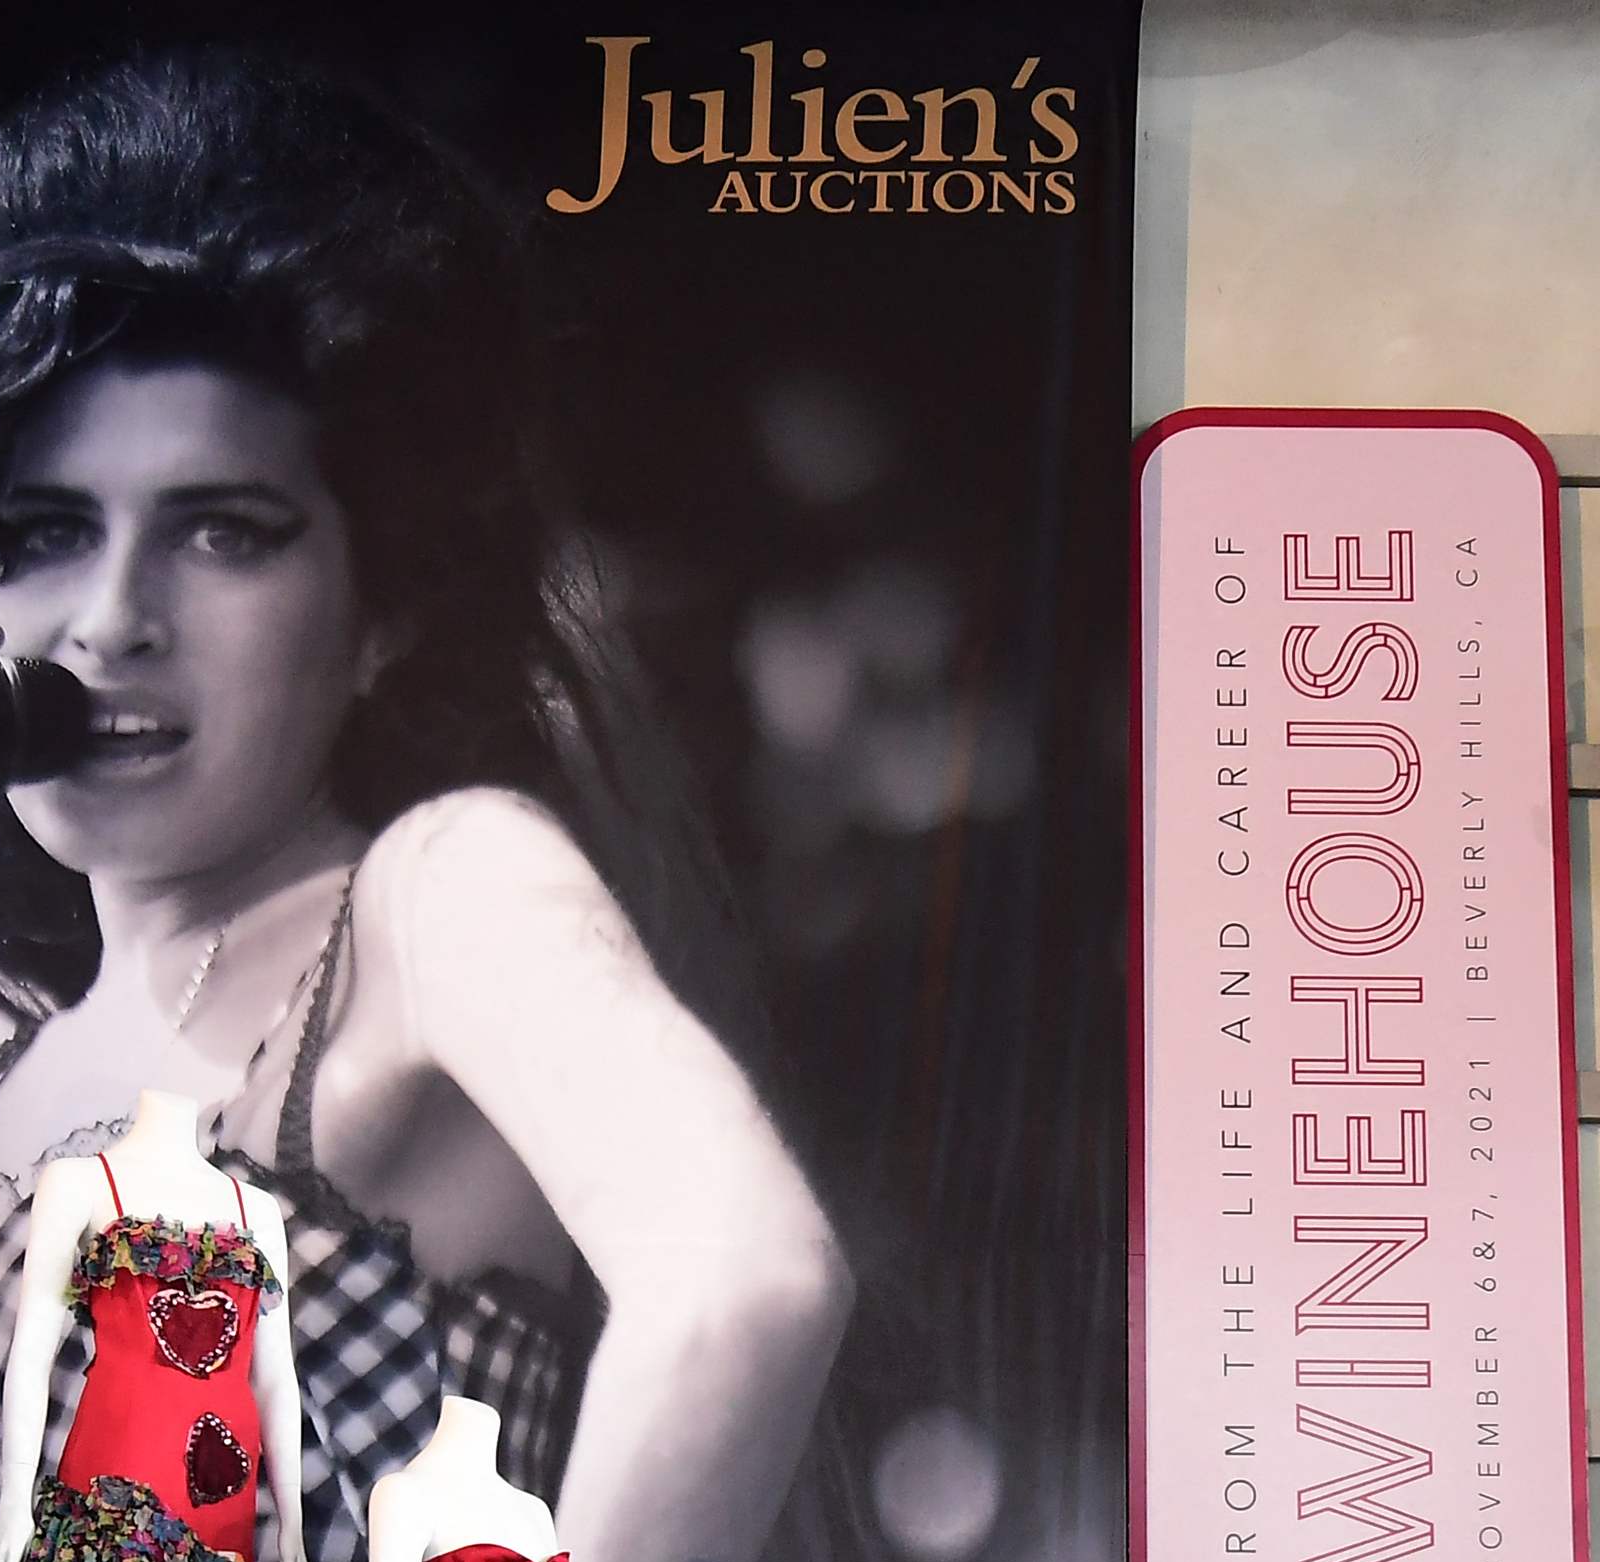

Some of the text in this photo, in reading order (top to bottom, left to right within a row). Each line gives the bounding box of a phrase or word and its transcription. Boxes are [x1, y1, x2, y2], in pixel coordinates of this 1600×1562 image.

[546, 36, 1079, 213] Julien's
[708, 171, 1077, 213] AUCTIONS
[1215, 537, 1247, 604] OF
[1455, 537, 1479, 587] CA
[1457, 619, 1484, 759] HILLS,
[1217, 647, 1249, 877] CAREER
[1462, 790, 1489, 982] BEVERLY
[1220, 921, 1252, 1043] AND
[1222, 1088, 1253, 1216] LIFE
[1468, 1059, 1495, 1162] 2021
[1223, 1264, 1255, 1376] THE
